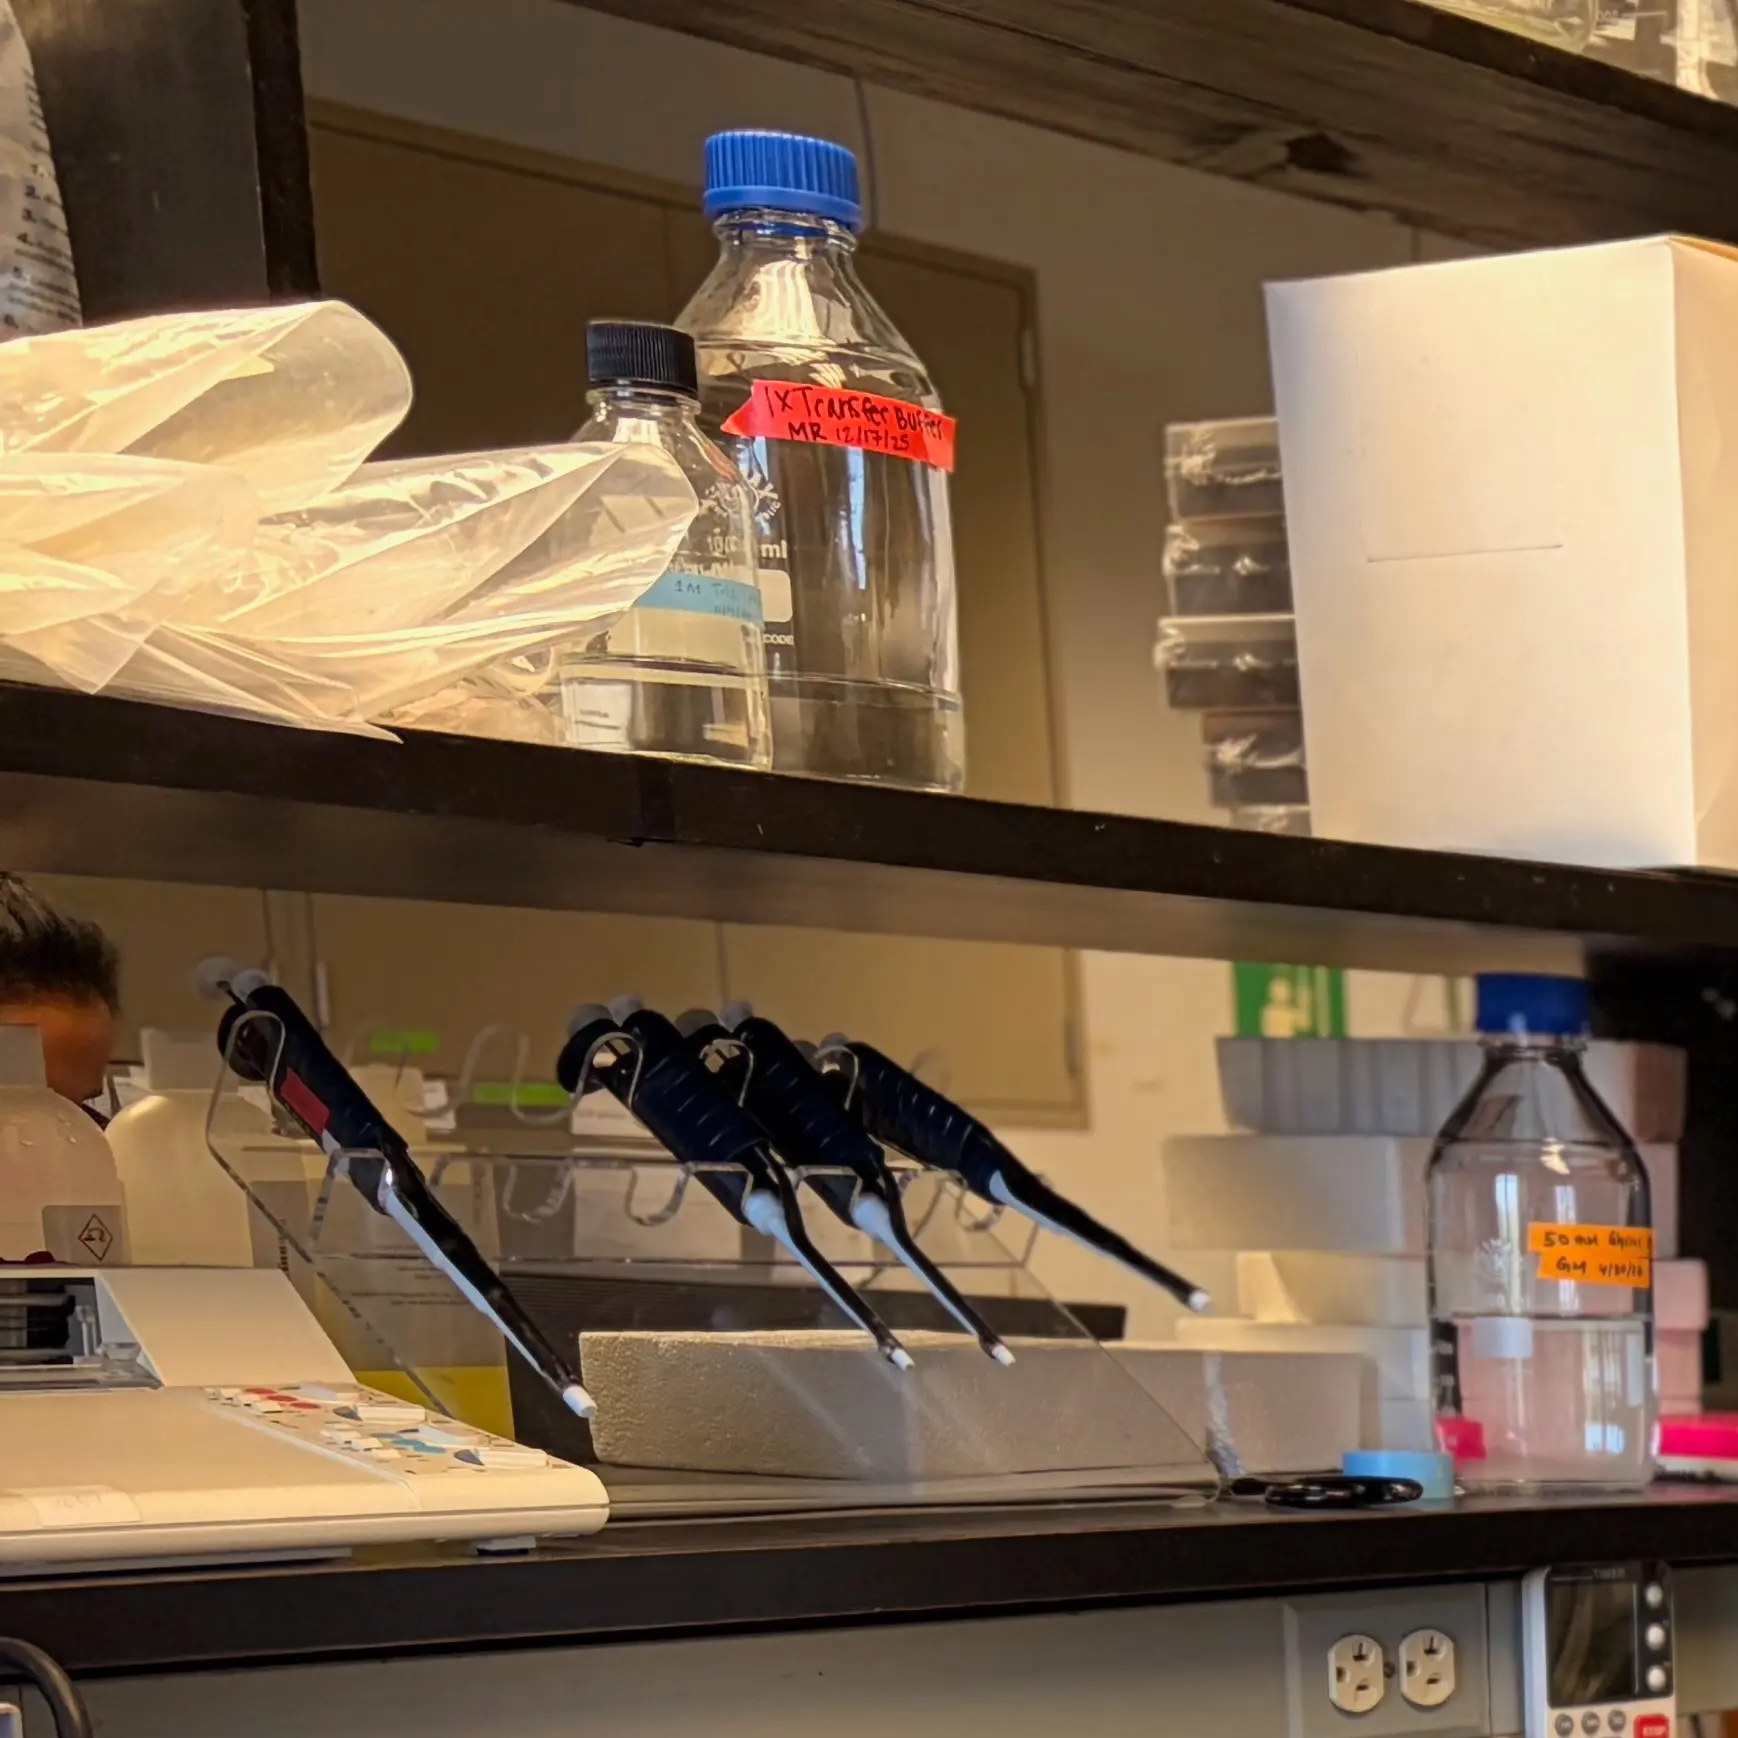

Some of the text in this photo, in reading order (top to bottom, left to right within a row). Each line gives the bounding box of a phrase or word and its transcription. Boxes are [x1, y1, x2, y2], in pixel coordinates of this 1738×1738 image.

[788, 386, 890, 426] Transfer
[787, 421, 829, 442] MR
[1543, 1230, 1570, 1248] 50
